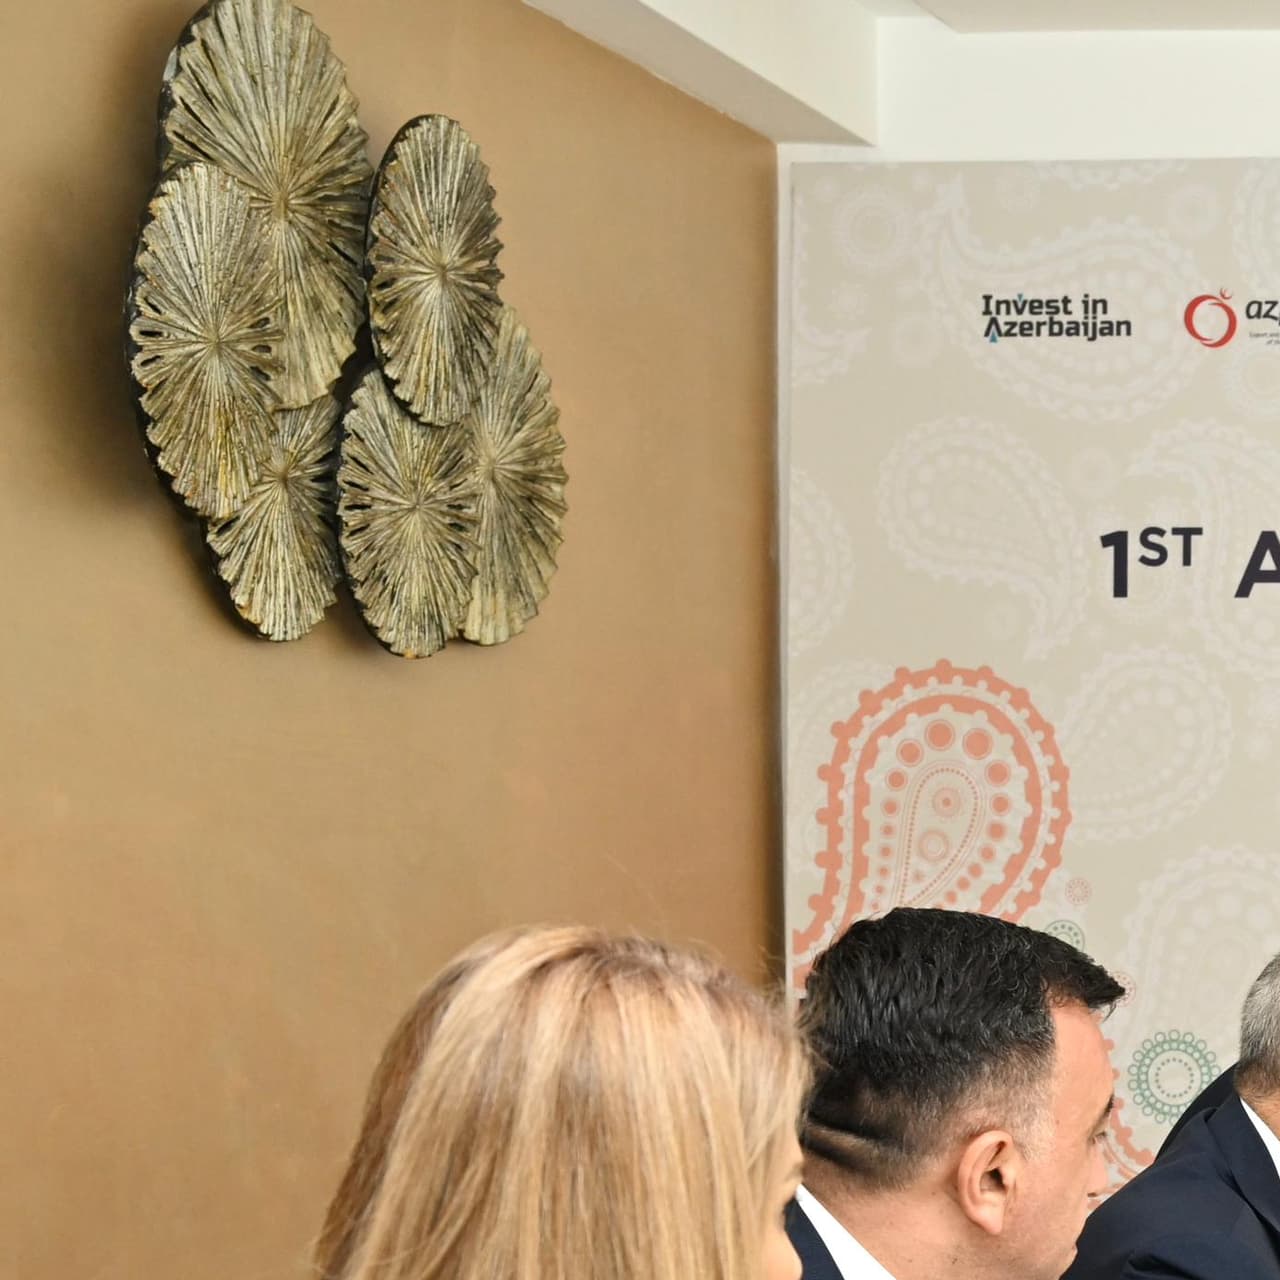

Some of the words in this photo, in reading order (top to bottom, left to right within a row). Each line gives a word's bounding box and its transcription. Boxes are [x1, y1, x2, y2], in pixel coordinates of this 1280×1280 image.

[981, 293, 1073, 316] Invest
[1081, 293, 1109, 316] in
[984, 316, 1132, 343] Azerbaijan
[1098, 526, 1204, 599] 1ST
